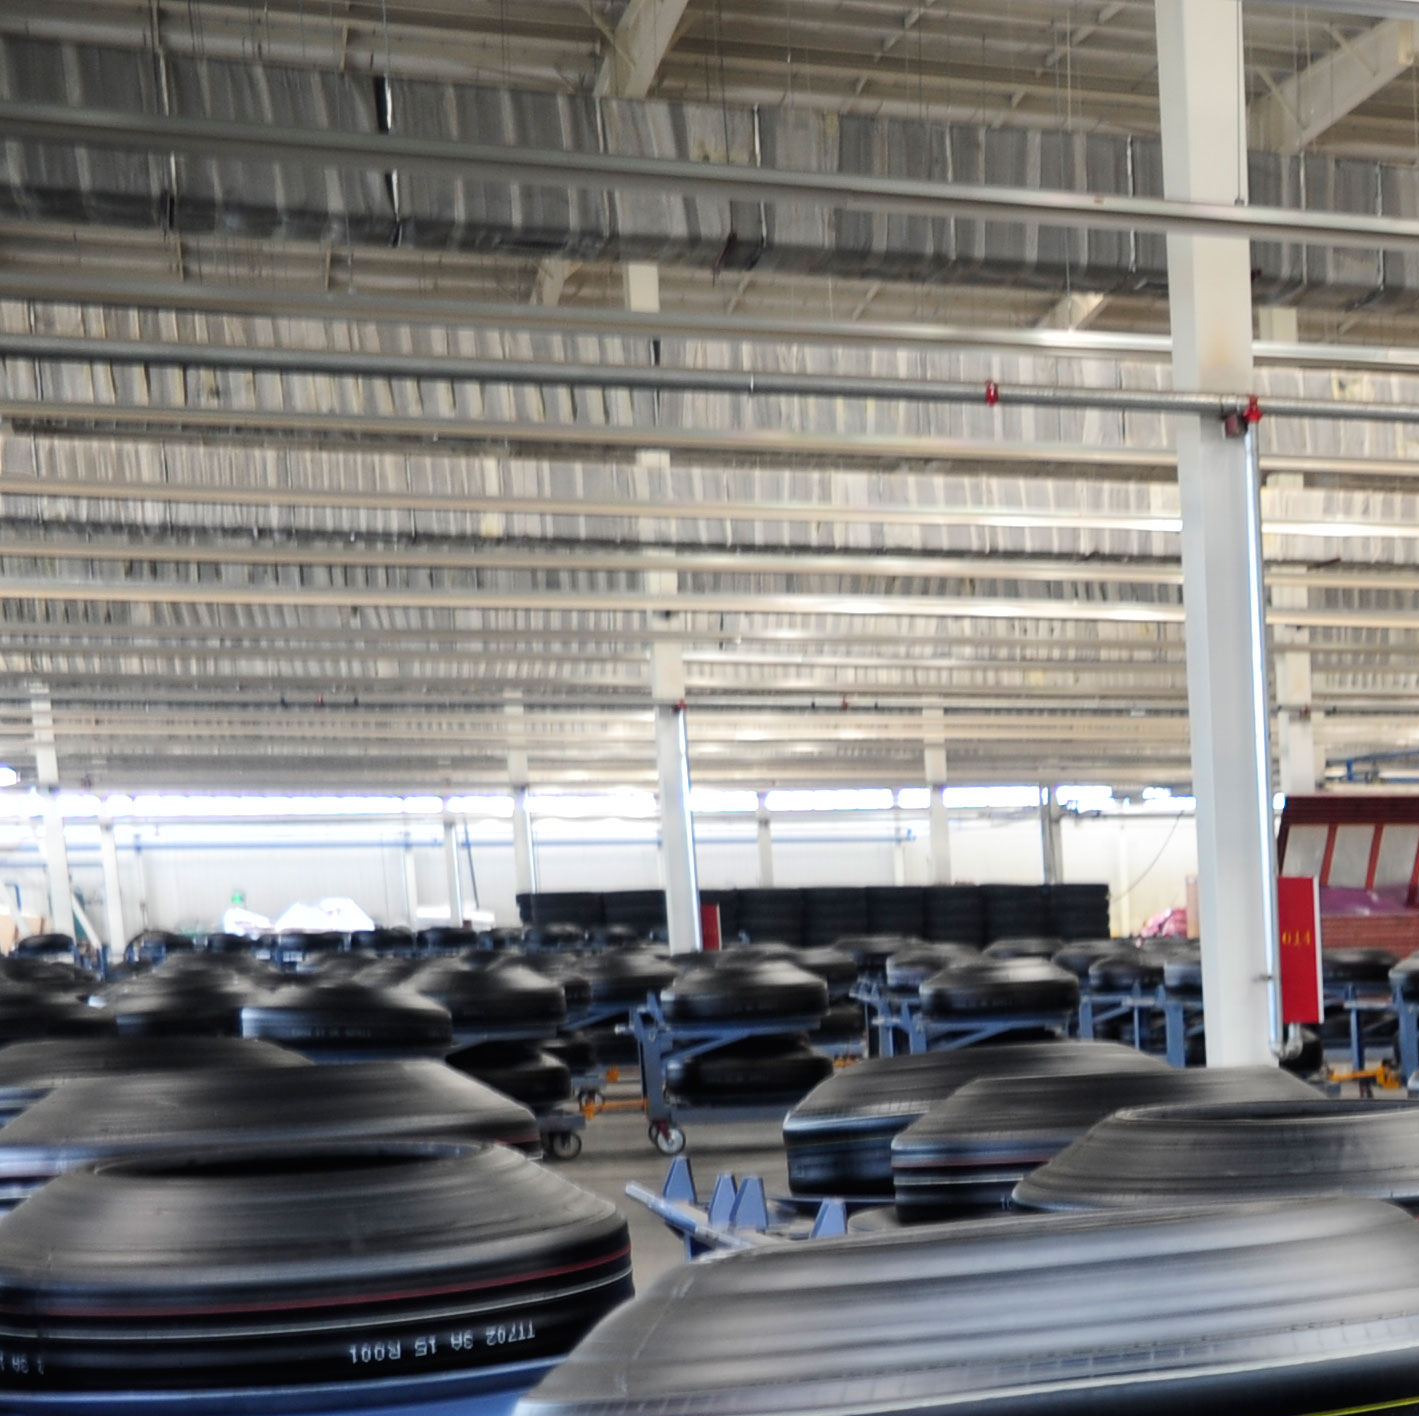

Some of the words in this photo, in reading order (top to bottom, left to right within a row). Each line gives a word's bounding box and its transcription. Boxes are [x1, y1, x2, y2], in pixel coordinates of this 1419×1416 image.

[451, 1329, 474, 1351] 3A
[486, 1319, 536, 1346] TT702
[350, 1339, 401, 1365] R001
[414, 1334, 438, 1357] 15
